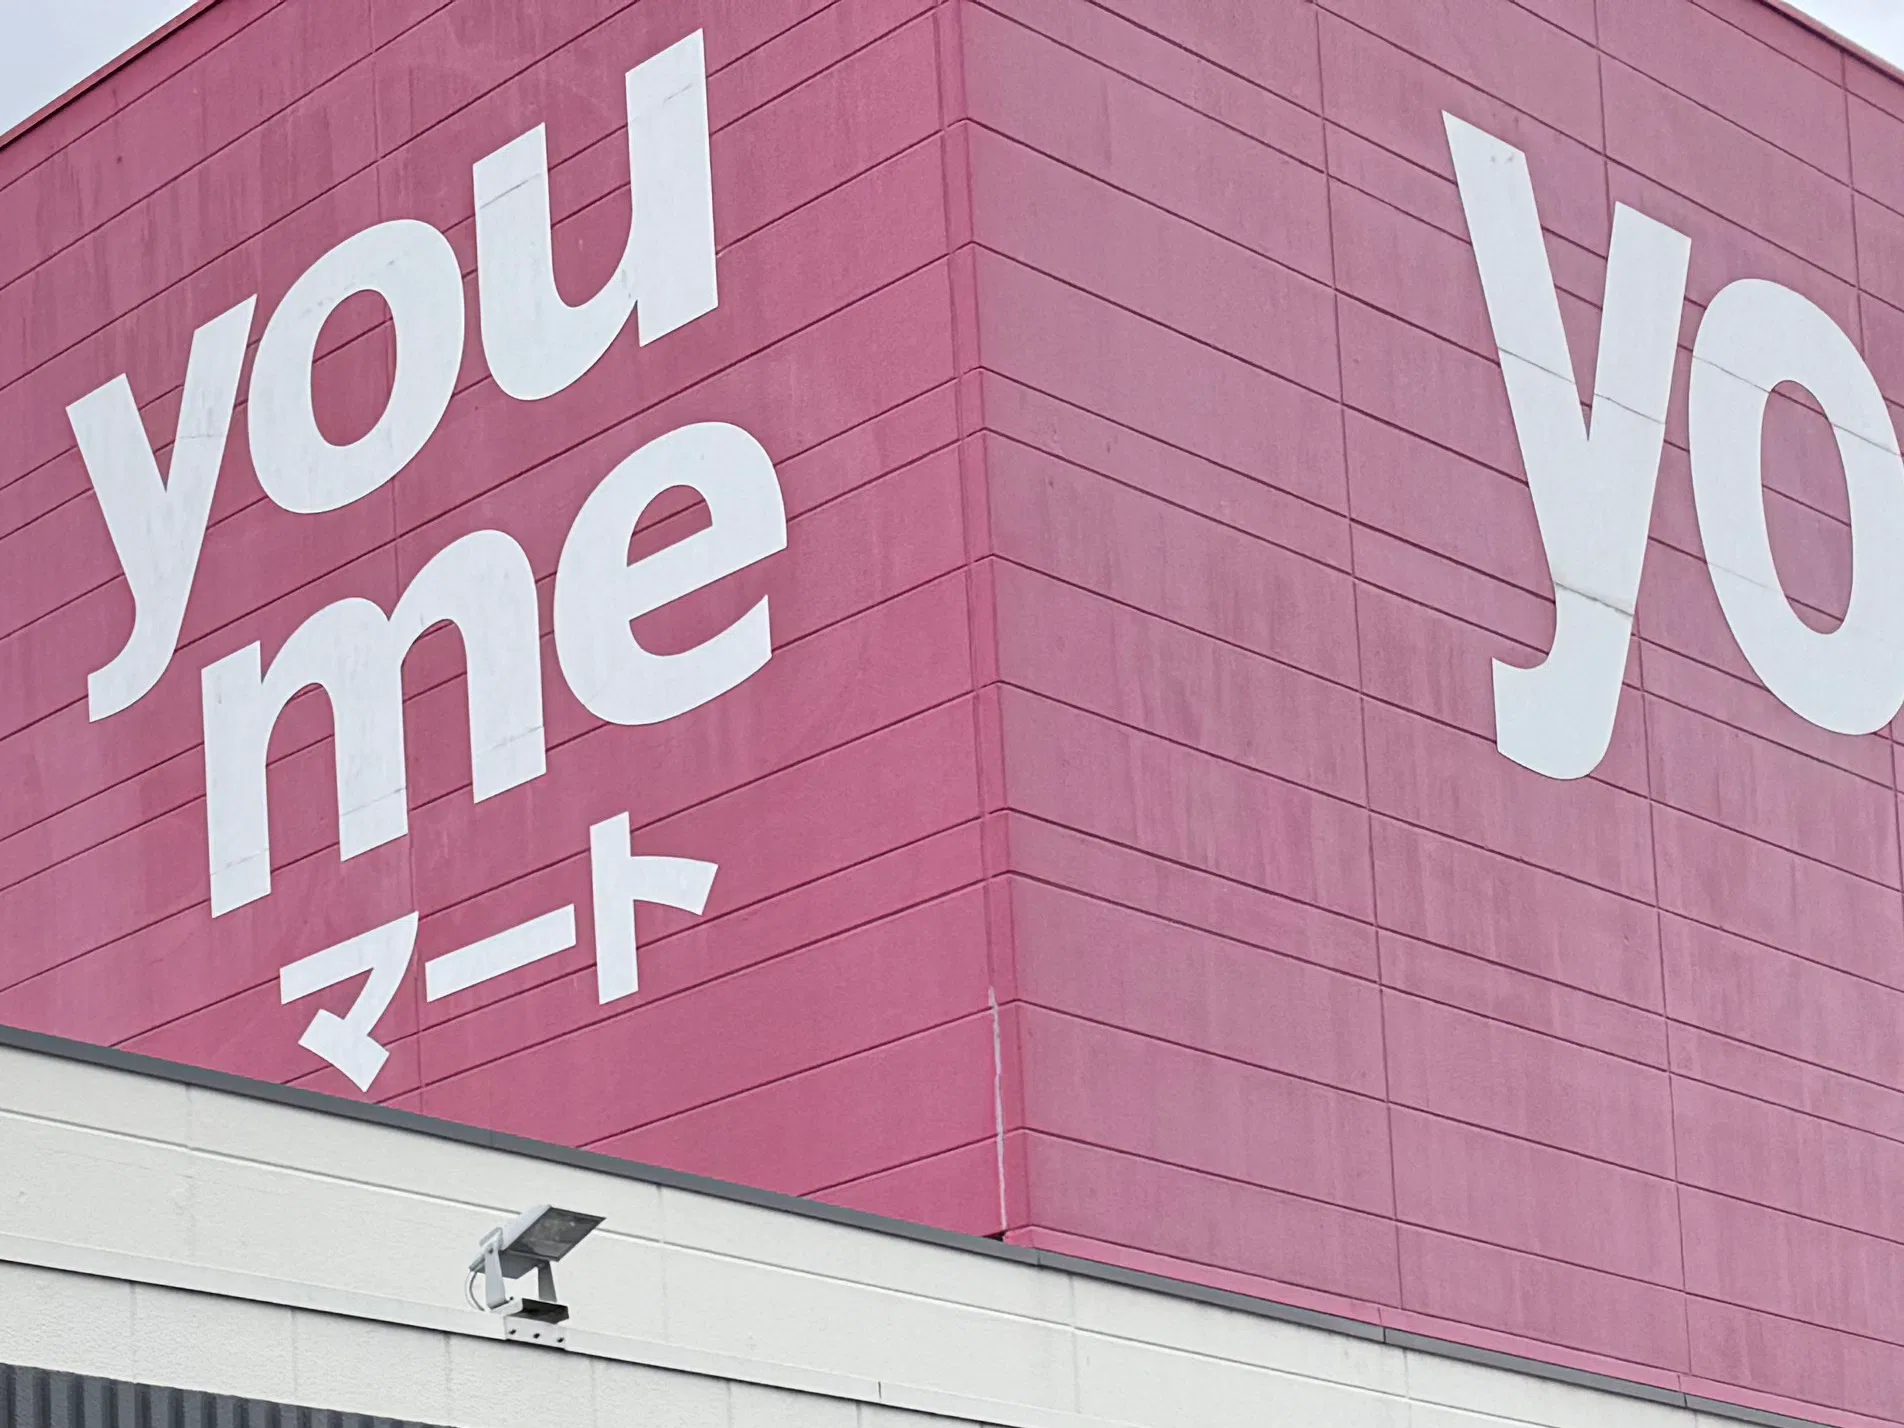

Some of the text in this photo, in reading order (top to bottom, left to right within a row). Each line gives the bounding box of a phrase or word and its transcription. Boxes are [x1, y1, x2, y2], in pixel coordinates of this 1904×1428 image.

[64, 28, 719, 721] you
[200, 421, 789, 917] me
[279, 810, 719, 1091] マート
